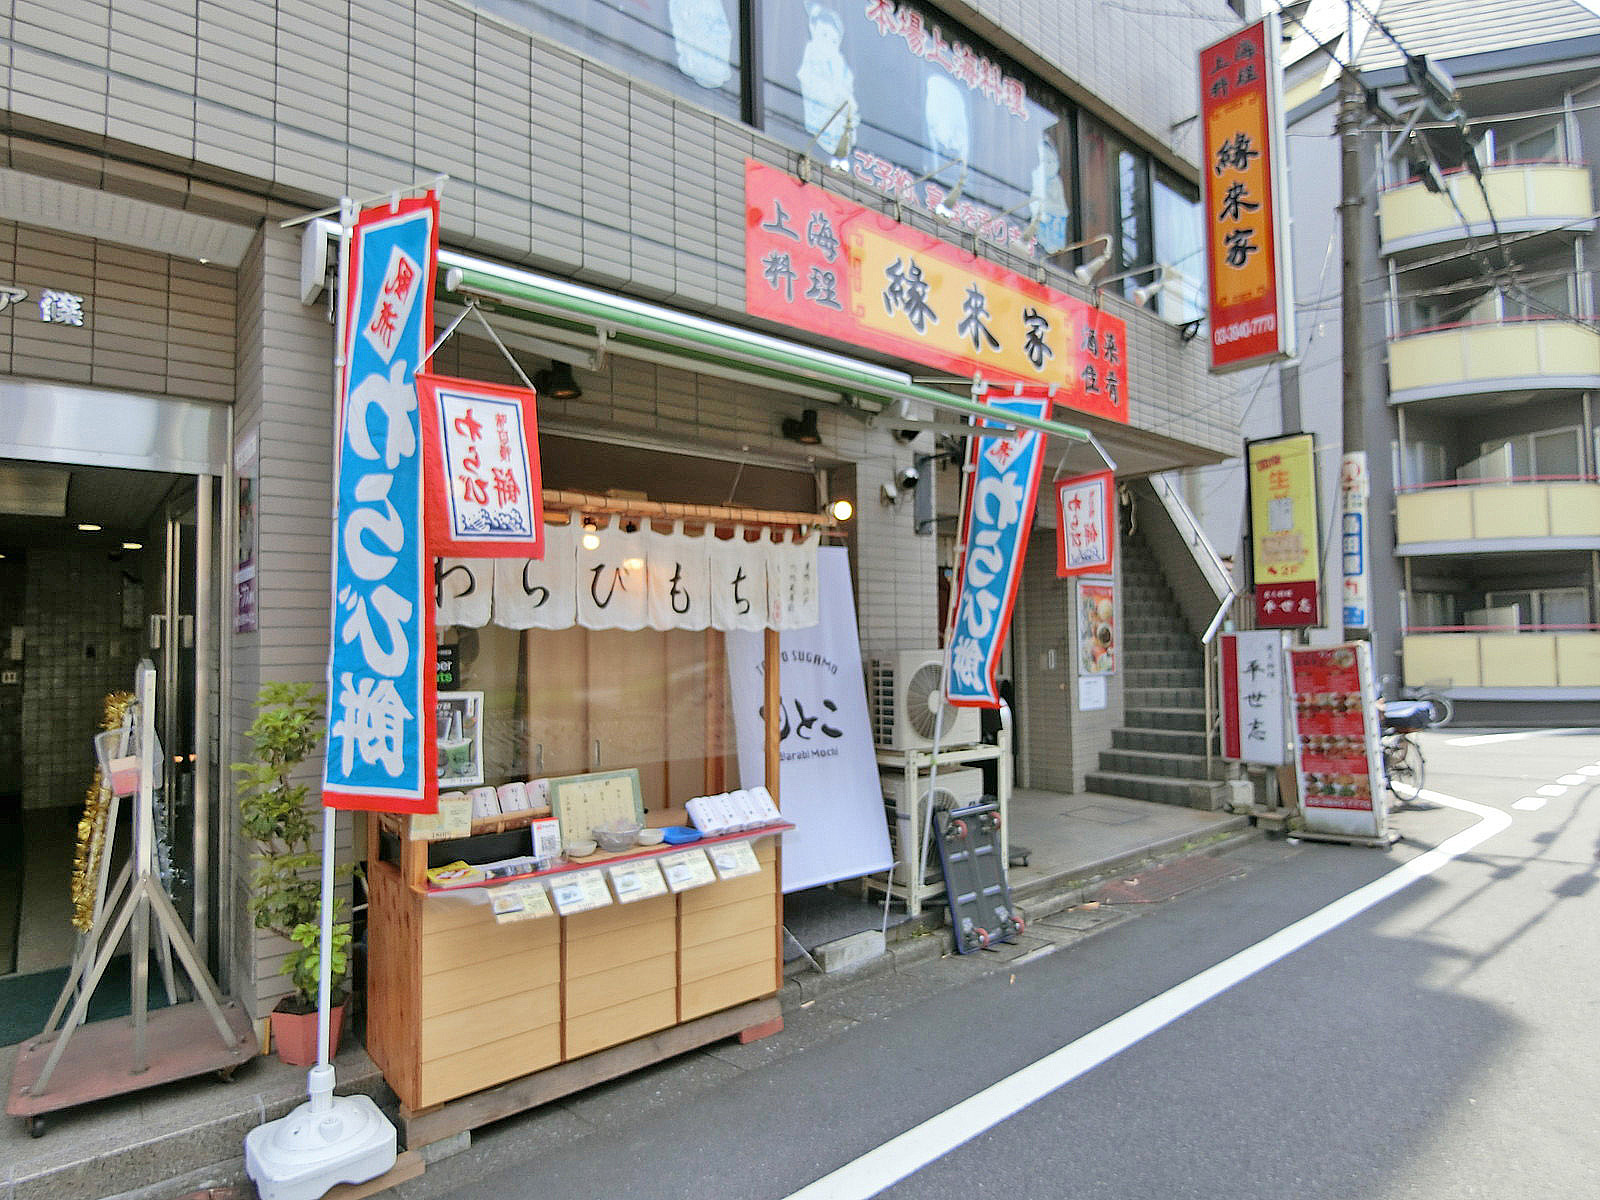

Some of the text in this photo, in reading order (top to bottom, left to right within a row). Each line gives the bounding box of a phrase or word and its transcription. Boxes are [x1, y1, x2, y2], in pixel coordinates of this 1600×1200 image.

[435, 556, 750, 614] わらびもち
[792, 650, 838, 675] SUGAMO
